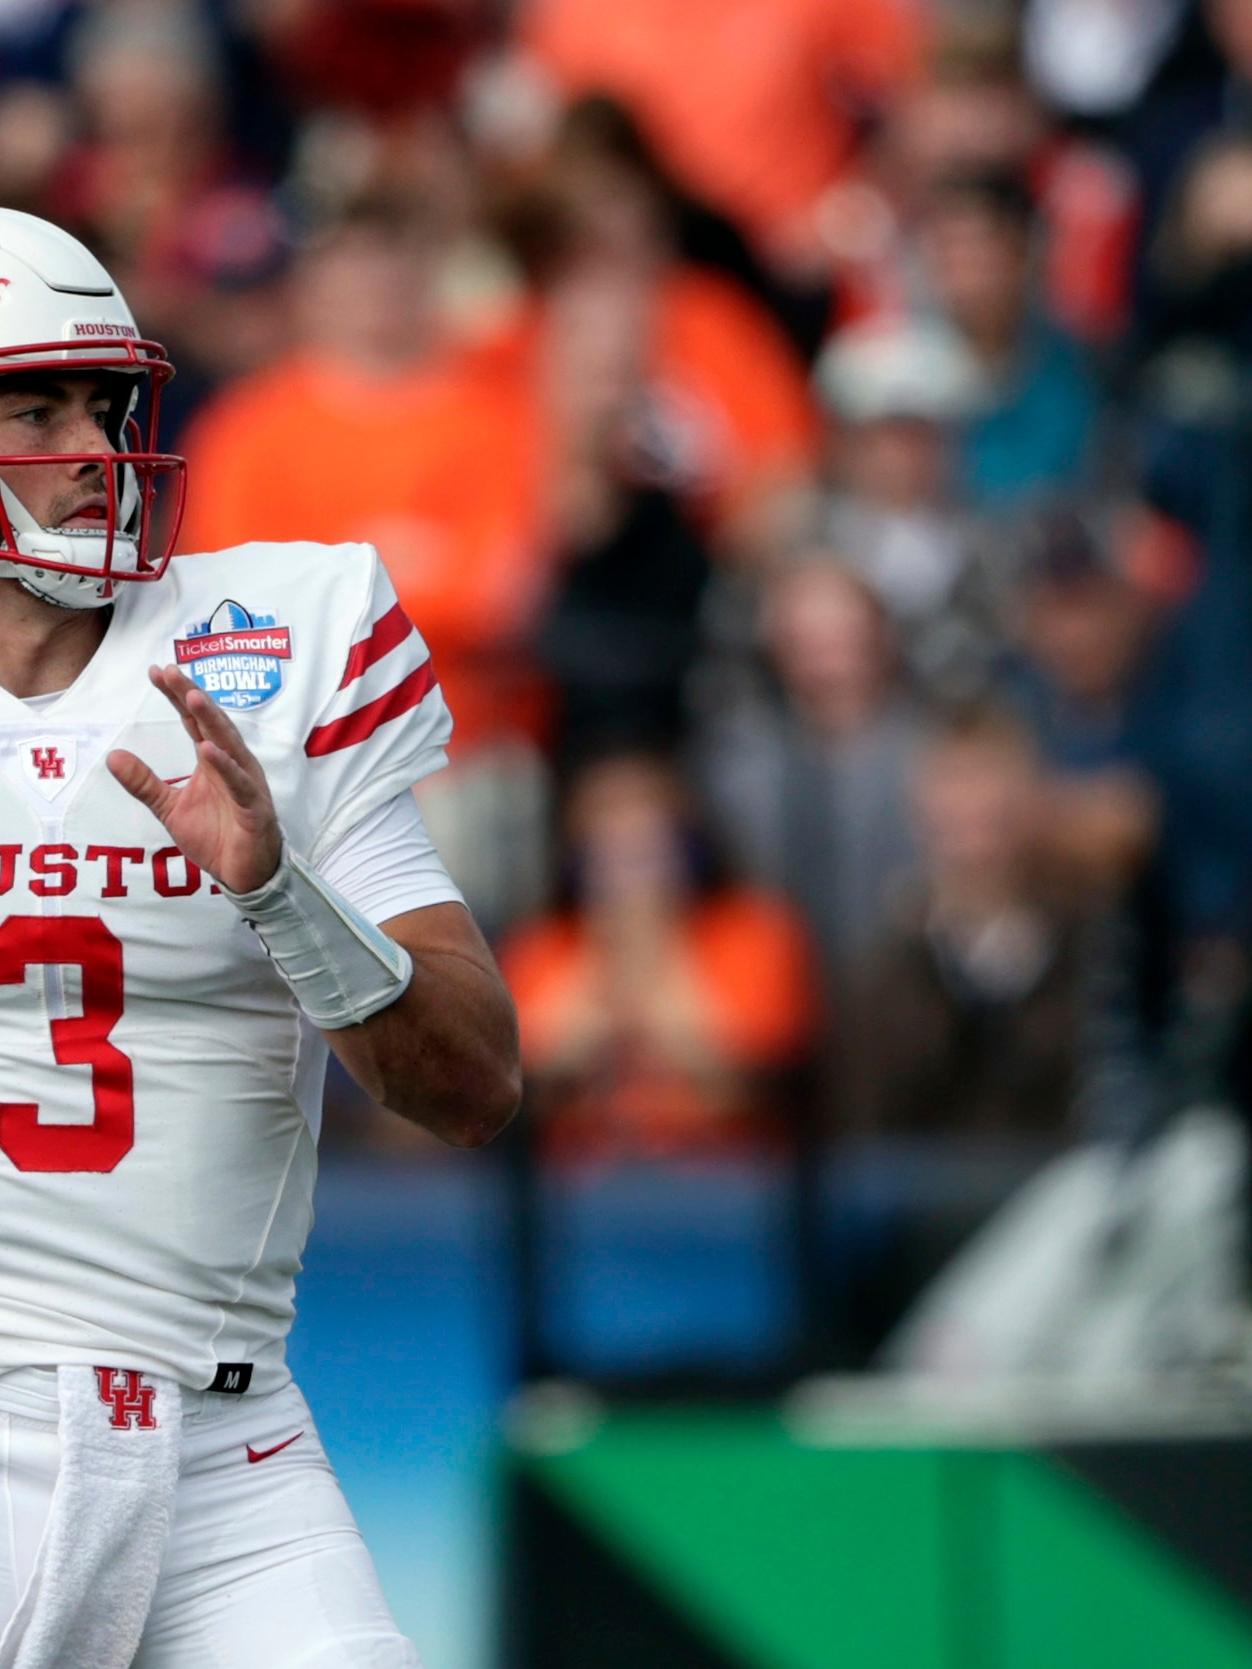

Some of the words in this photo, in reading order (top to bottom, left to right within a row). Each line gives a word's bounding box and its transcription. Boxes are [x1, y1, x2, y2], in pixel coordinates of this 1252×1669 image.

[74, 323, 136, 338] HOUSTON
[177, 635, 289, 657] TicketSmarter
[194, 656, 278, 676] BIRMINGHAM
[203, 670, 271, 692] BOWL
[223, 1370, 241, 1390] M
